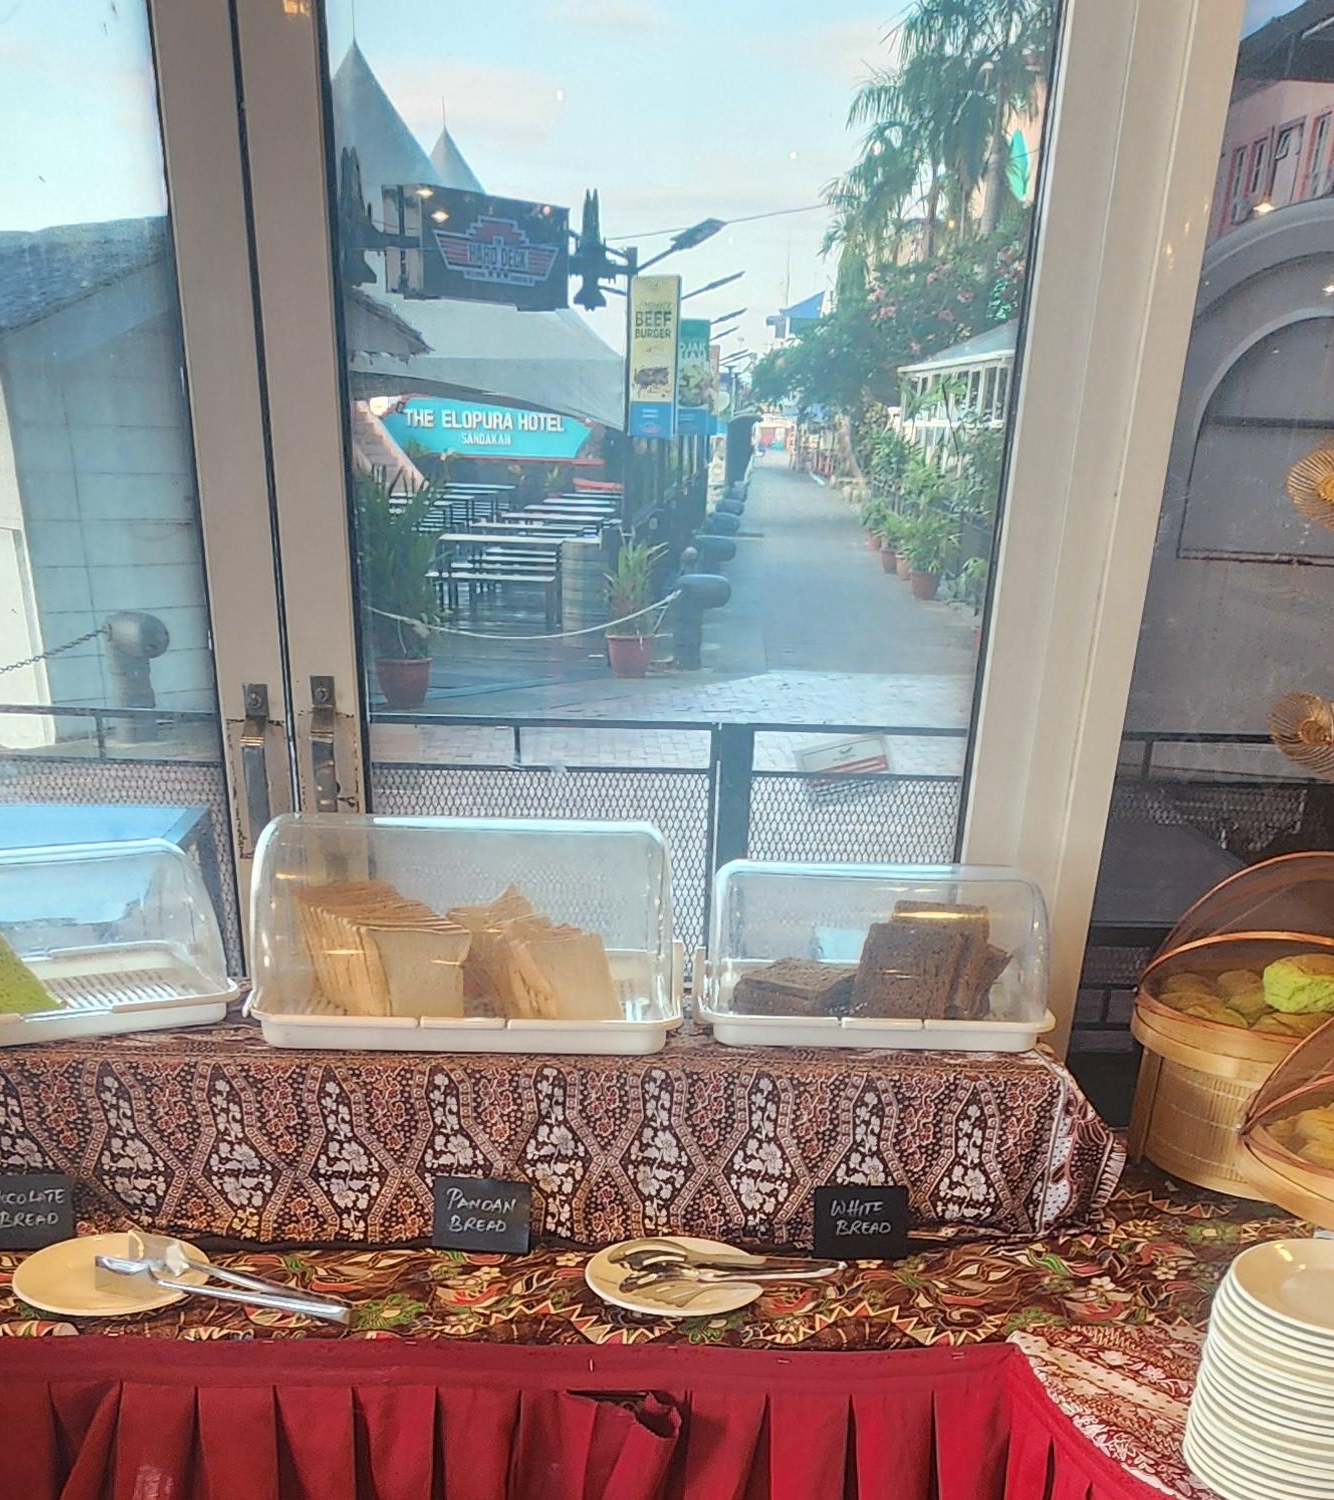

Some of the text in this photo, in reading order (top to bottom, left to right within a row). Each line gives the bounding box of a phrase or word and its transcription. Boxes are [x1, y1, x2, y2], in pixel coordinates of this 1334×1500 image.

[467, 242, 529, 272] HARD DECK
[635, 310, 672, 327] BEEF
[634, 328, 671, 339] BURGER
[404, 408, 565, 433] THE ELOPURA HOTEL
[460, 432, 512, 446] SANDAKAN
[830, 1199, 884, 1217] WHITE
[449, 1214, 507, 1233] BREAD
[835, 1219, 892, 1236] BREAD
